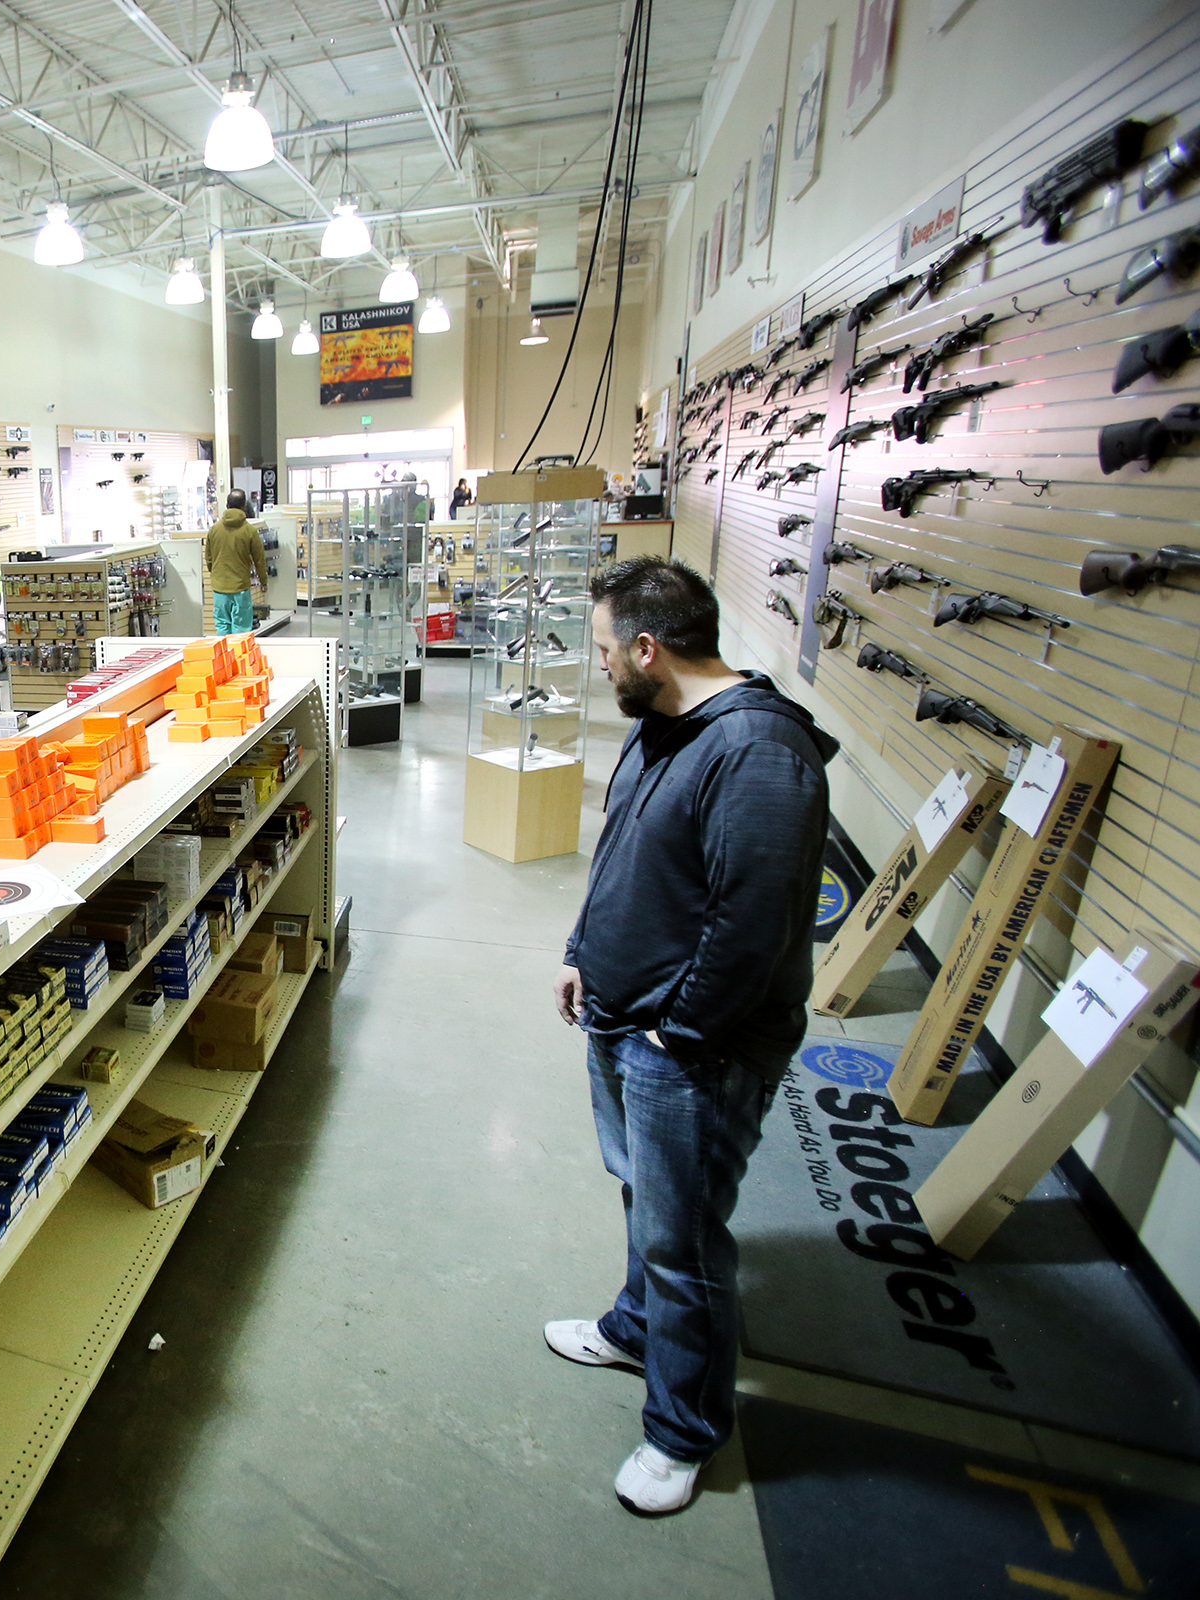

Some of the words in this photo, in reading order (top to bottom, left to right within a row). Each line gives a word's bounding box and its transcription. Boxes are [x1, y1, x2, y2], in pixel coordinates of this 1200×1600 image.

[910, 221, 935, 248] Savage
[933, 206, 957, 232] Arms
[342, 306, 410, 321] KALASHNIKOV
[342, 320, 360, 329] USA
[363, 350, 407, 359] INNOVATION
[961, 803, 985, 834] M&P
[985, 790, 1003, 811] RIFLES
[1039, 782, 1093, 866] CRAFTSMEN
[896, 891, 919, 919] M&P
[1002, 868, 1049, 942] AMERICAN
[944, 935, 974, 993] Marlin
[997, 942, 1013, 963] BY
[979, 962, 1004, 990] USA
[964, 990, 988, 1016] THE
[1152, 1001, 1168, 1018] SIG
[1166, 984, 1190, 1010] SAUER
[955, 1017, 974, 1036] IN
[936, 1036, 967, 1073] MADE
[781, 1083, 805, 1102] As
[1023, 1082, 1040, 1103] SIG
[787, 1102, 820, 1136] Hard
[798, 1135, 823, 1156] As
[805, 1158, 832, 1186] You
[816, 1188, 842, 1212] Do
[814, 1087, 1008, 1375] Stoeger
